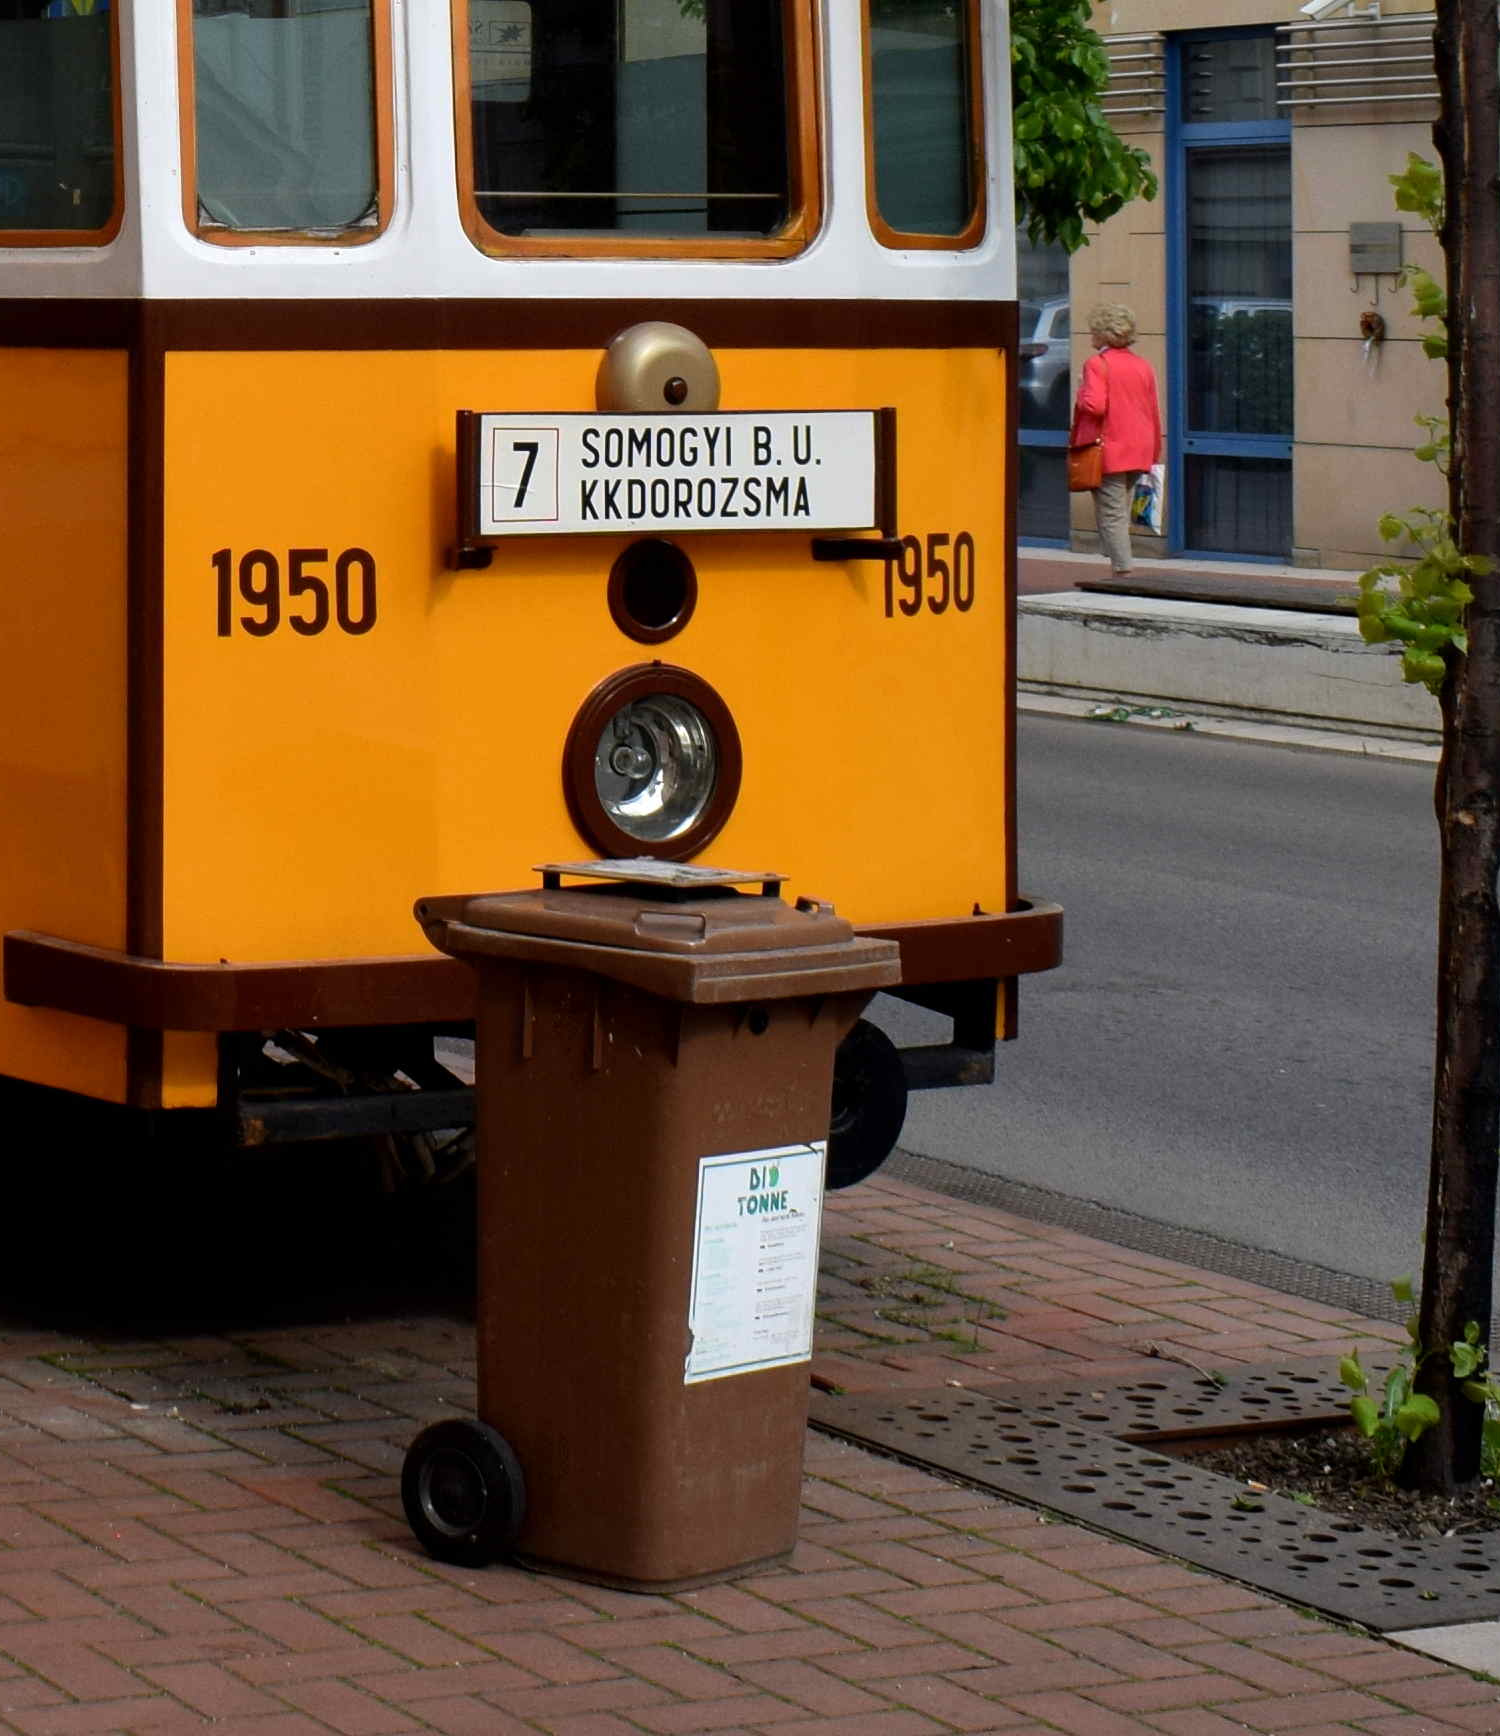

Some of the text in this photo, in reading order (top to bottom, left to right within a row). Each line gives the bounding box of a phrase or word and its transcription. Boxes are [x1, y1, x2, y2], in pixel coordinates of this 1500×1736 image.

[582, 425, 821, 468] SOMOGYI B. U.
[512, 442, 539, 507] 7
[581, 476, 811, 520] KKDOROZSMA
[211, 548, 377, 637] 1950
[884, 531, 975, 618] 1950
[737, 1190, 789, 1217] TONNE
